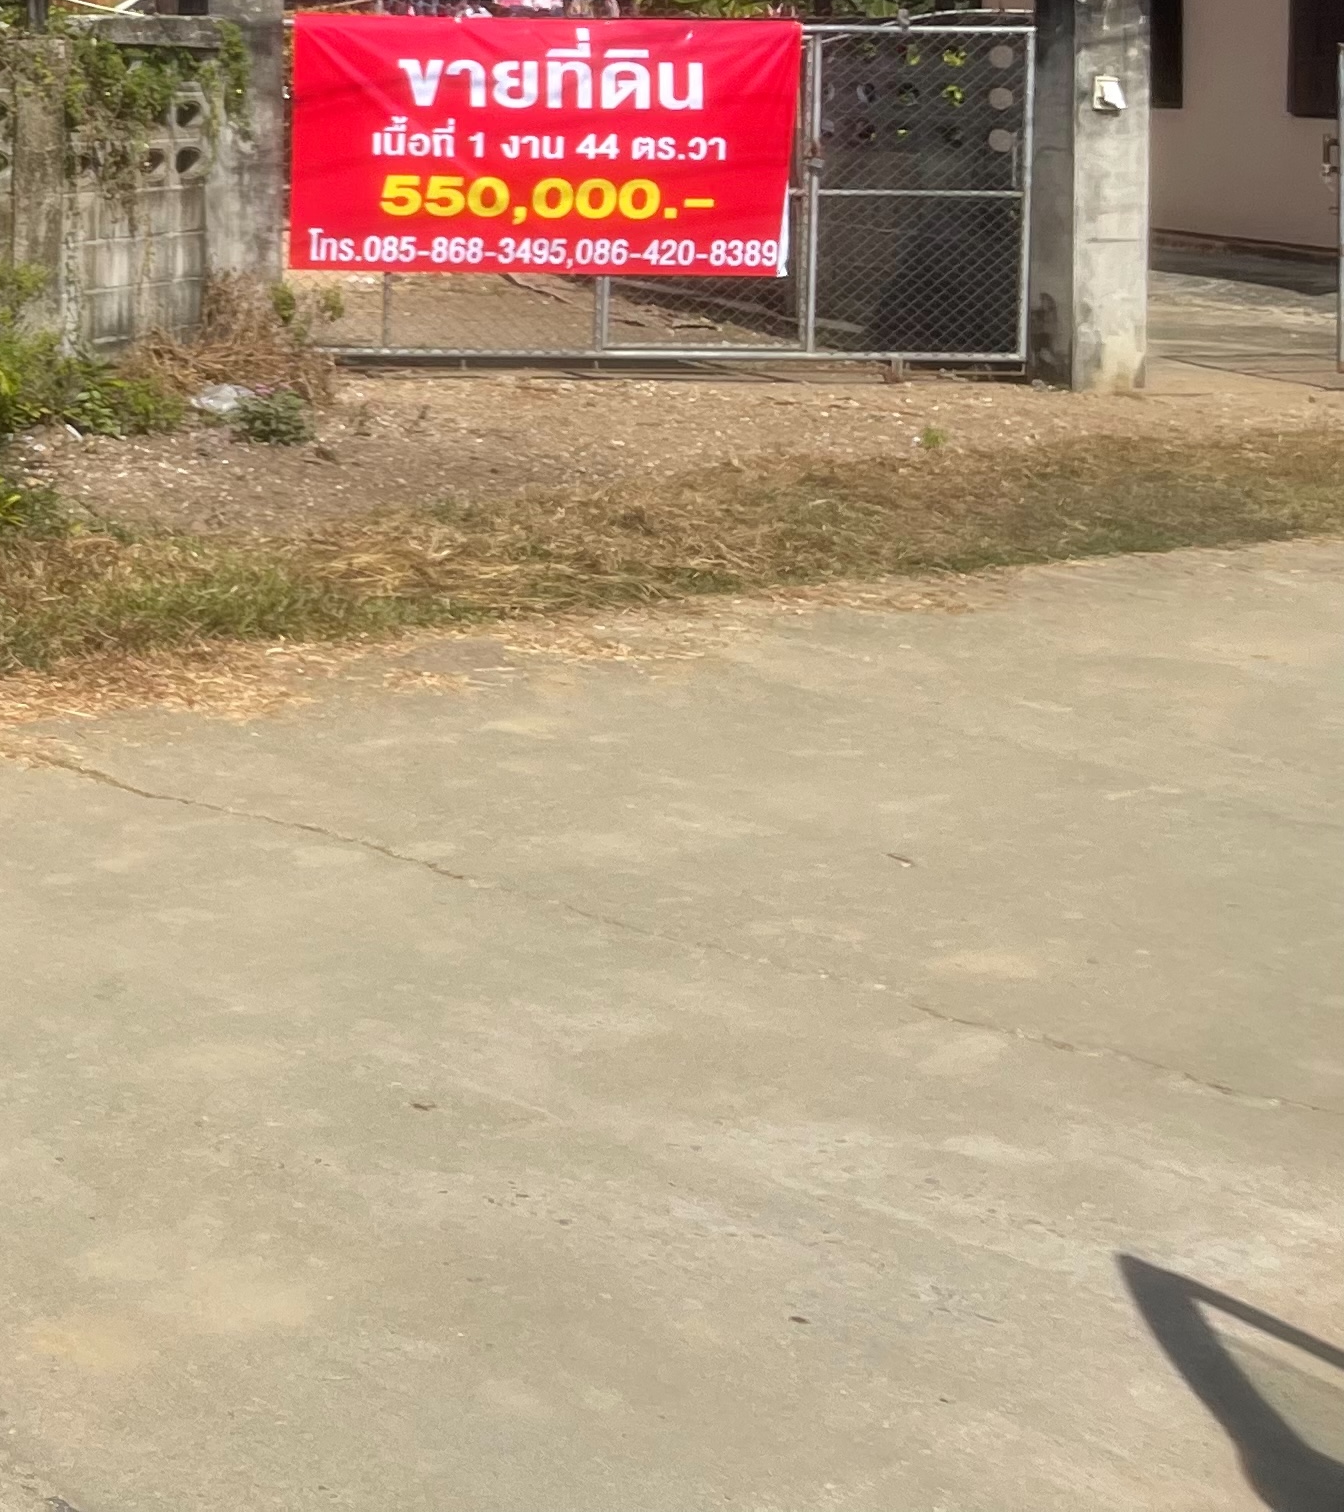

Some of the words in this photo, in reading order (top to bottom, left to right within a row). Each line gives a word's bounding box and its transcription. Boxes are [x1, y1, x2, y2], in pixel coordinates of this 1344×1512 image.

[397, 27, 705, 111] ขายที่ดิน
[371, 116, 456, 159] เนื้อที่
[467, 132, 485, 159] 1
[499, 134, 565, 160] งาน
[574, 133, 621, 160] 44
[630, 136, 727, 161] ตร.วา
[379, 174, 716, 226] 550,000.-
